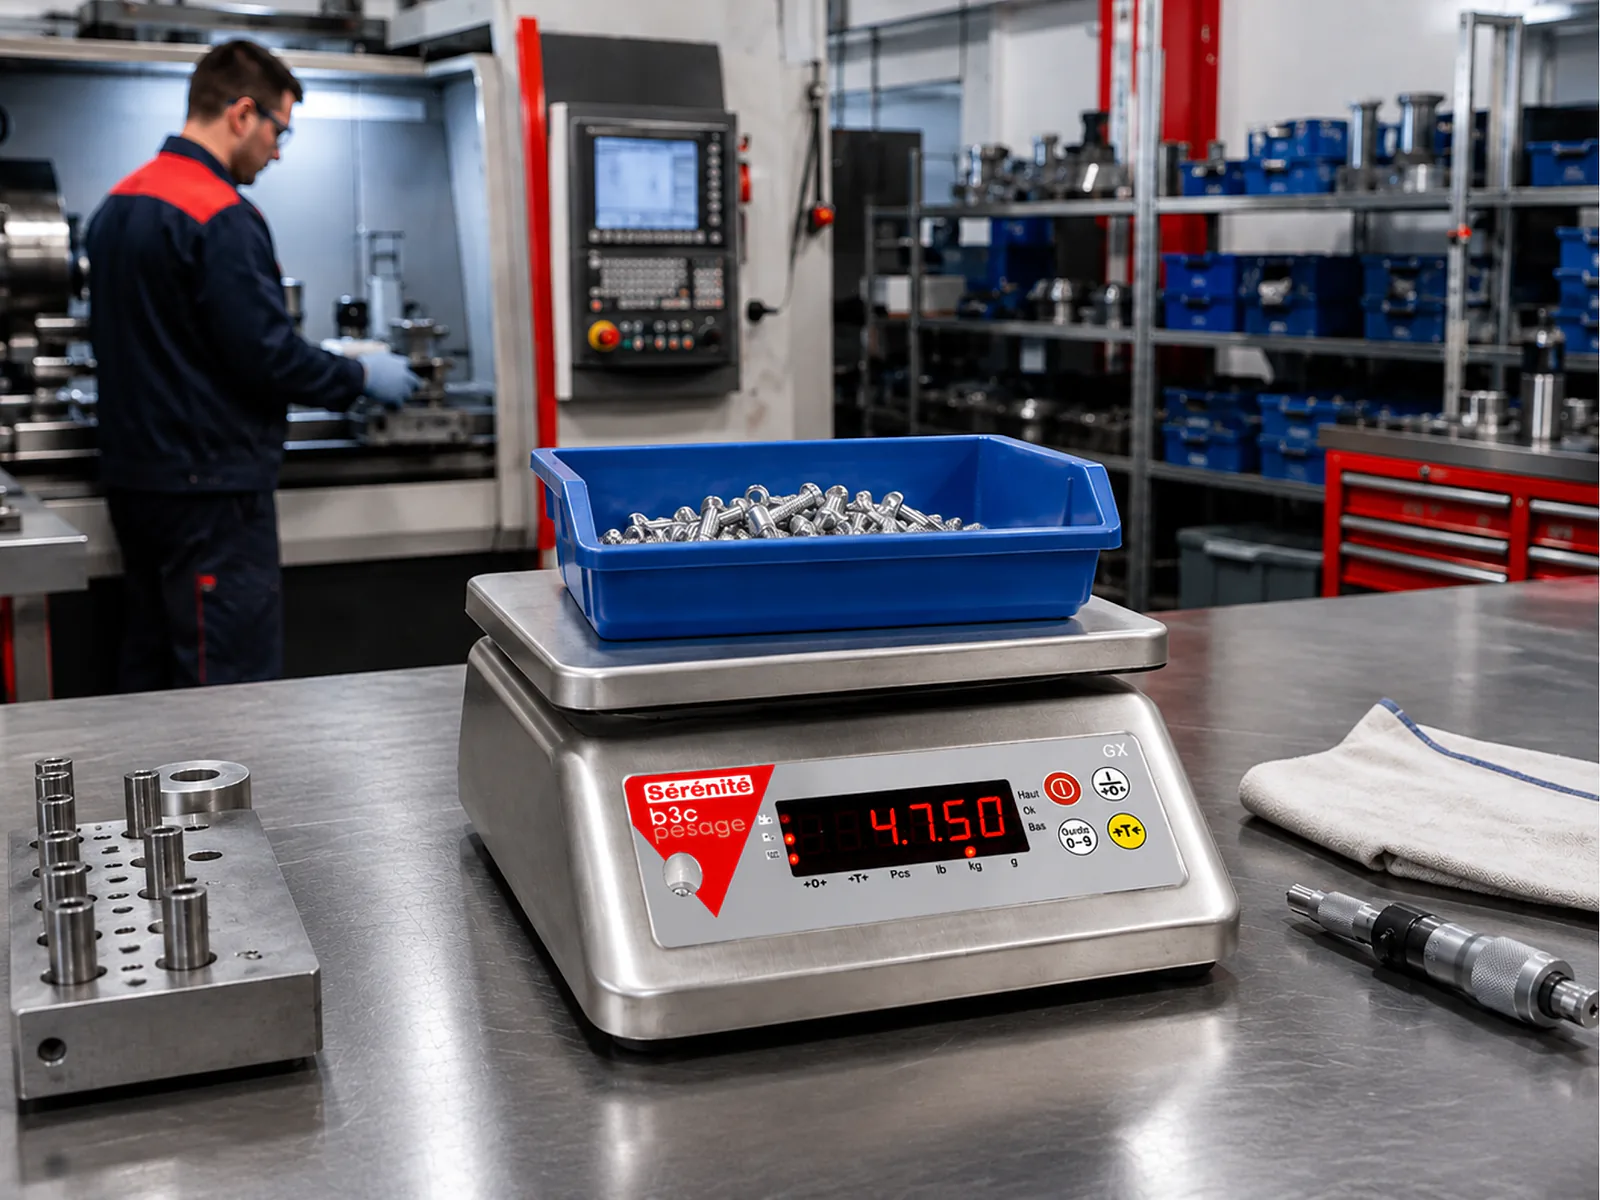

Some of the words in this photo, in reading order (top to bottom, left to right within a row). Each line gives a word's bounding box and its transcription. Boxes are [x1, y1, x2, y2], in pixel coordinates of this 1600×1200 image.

[1102, 743, 1129, 758] GX
[647, 777, 752, 801] Sérénité
[1017, 790, 1040, 800] Haut
[649, 806, 699, 826] b3c
[654, 818, 746, 844] pesage
[1028, 822, 1046, 831] Bas
[1066, 835, 1092, 849] 0-9
[890, 869, 911, 879] Pcs
[935, 865, 947, 874] lb
[968, 861, 982, 872] kg
[1010, 858, 1018, 868] g
